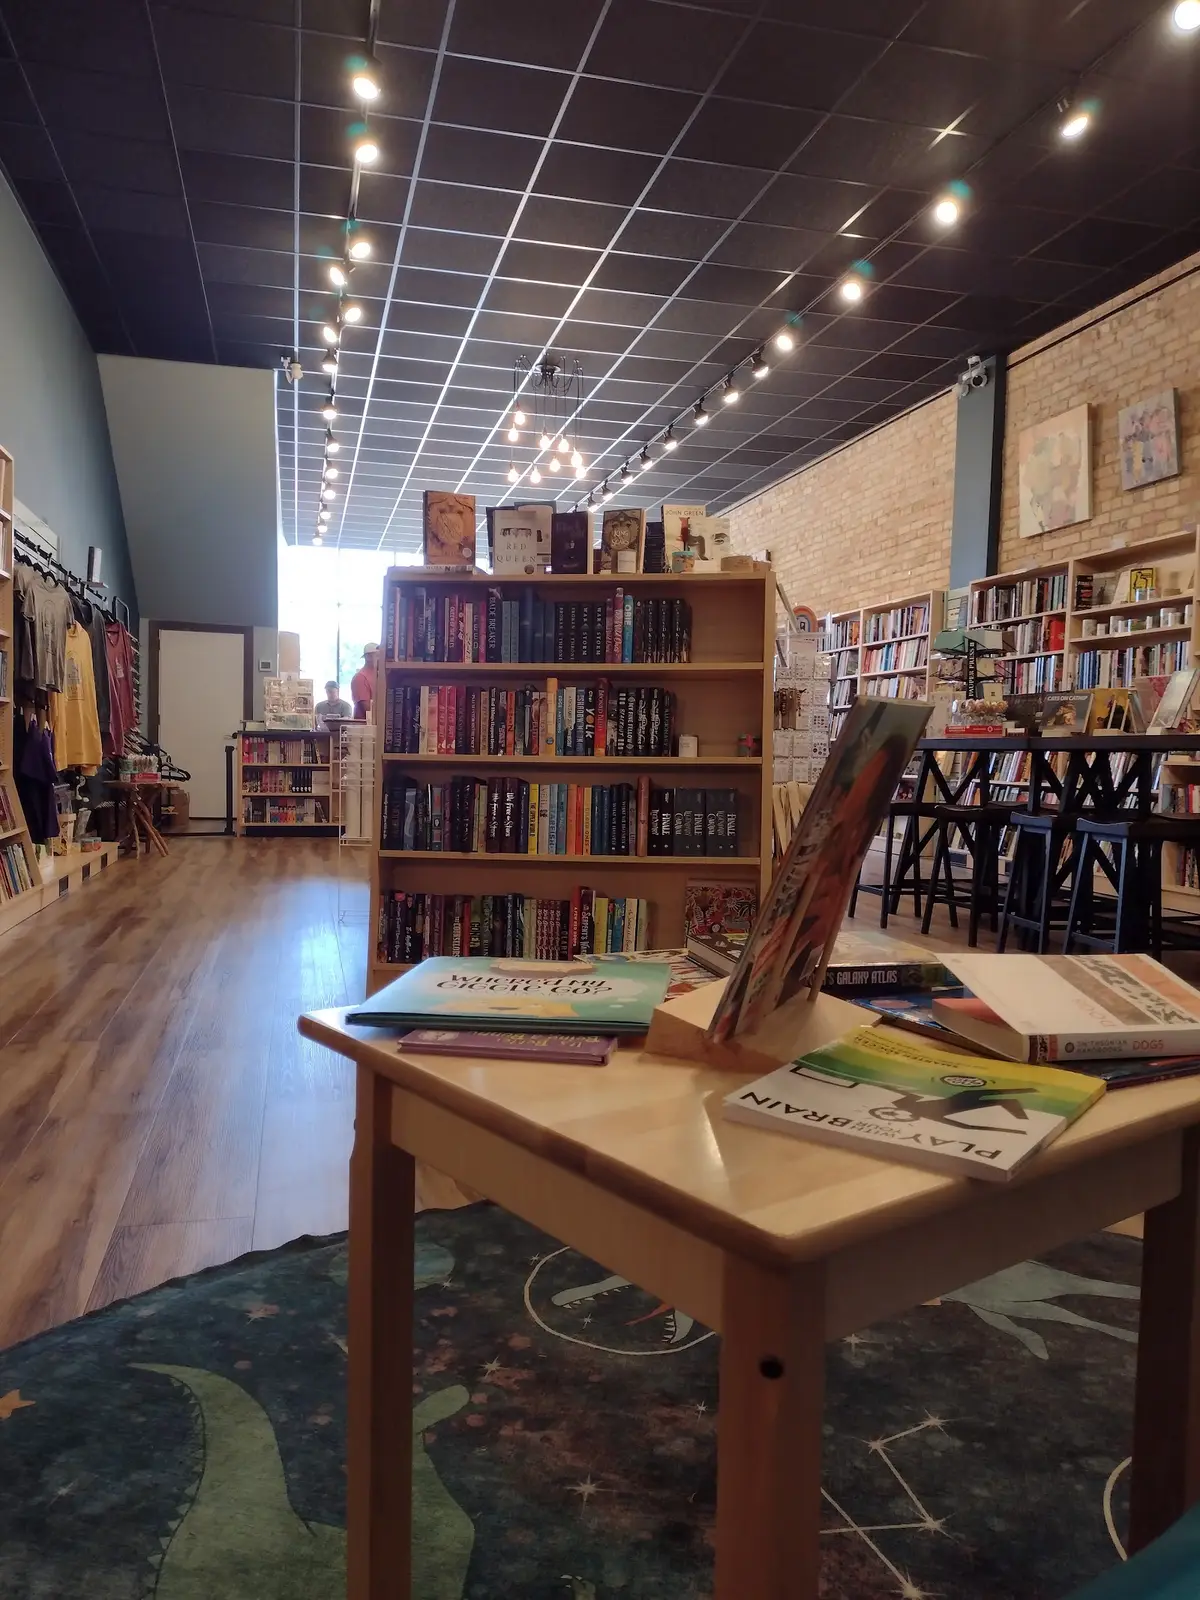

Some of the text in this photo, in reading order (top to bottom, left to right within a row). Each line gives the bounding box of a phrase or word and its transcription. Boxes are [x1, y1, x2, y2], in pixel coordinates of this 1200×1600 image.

[665, 509, 704, 517] JOHN GREEN
[506, 543, 527, 551] RED
[496, 556, 536, 564] QUEEN
[624, 604, 632, 626] OBIE
[488, 618, 496, 649] BREAKER
[504, 821, 514, 837] Stars
[662, 813, 671, 836] FINALE
[694, 813, 704, 836] FINALE
[727, 813, 737, 837] FINALE
[581, 911, 591, 940] SERPENT'S
[452, 922, 461, 957] COUNSELORS
[836, 970, 870, 986] GALAXY
[871, 970, 898, 985] ATLAS
[550, 985, 613, 996] GO?
[1132, 1038, 1165, 1051] DOGS
[738, 1090, 853, 1128] BRAIN
[848, 1123, 897, 1141] WITH
[899, 1131, 1003, 1160] PLAY
